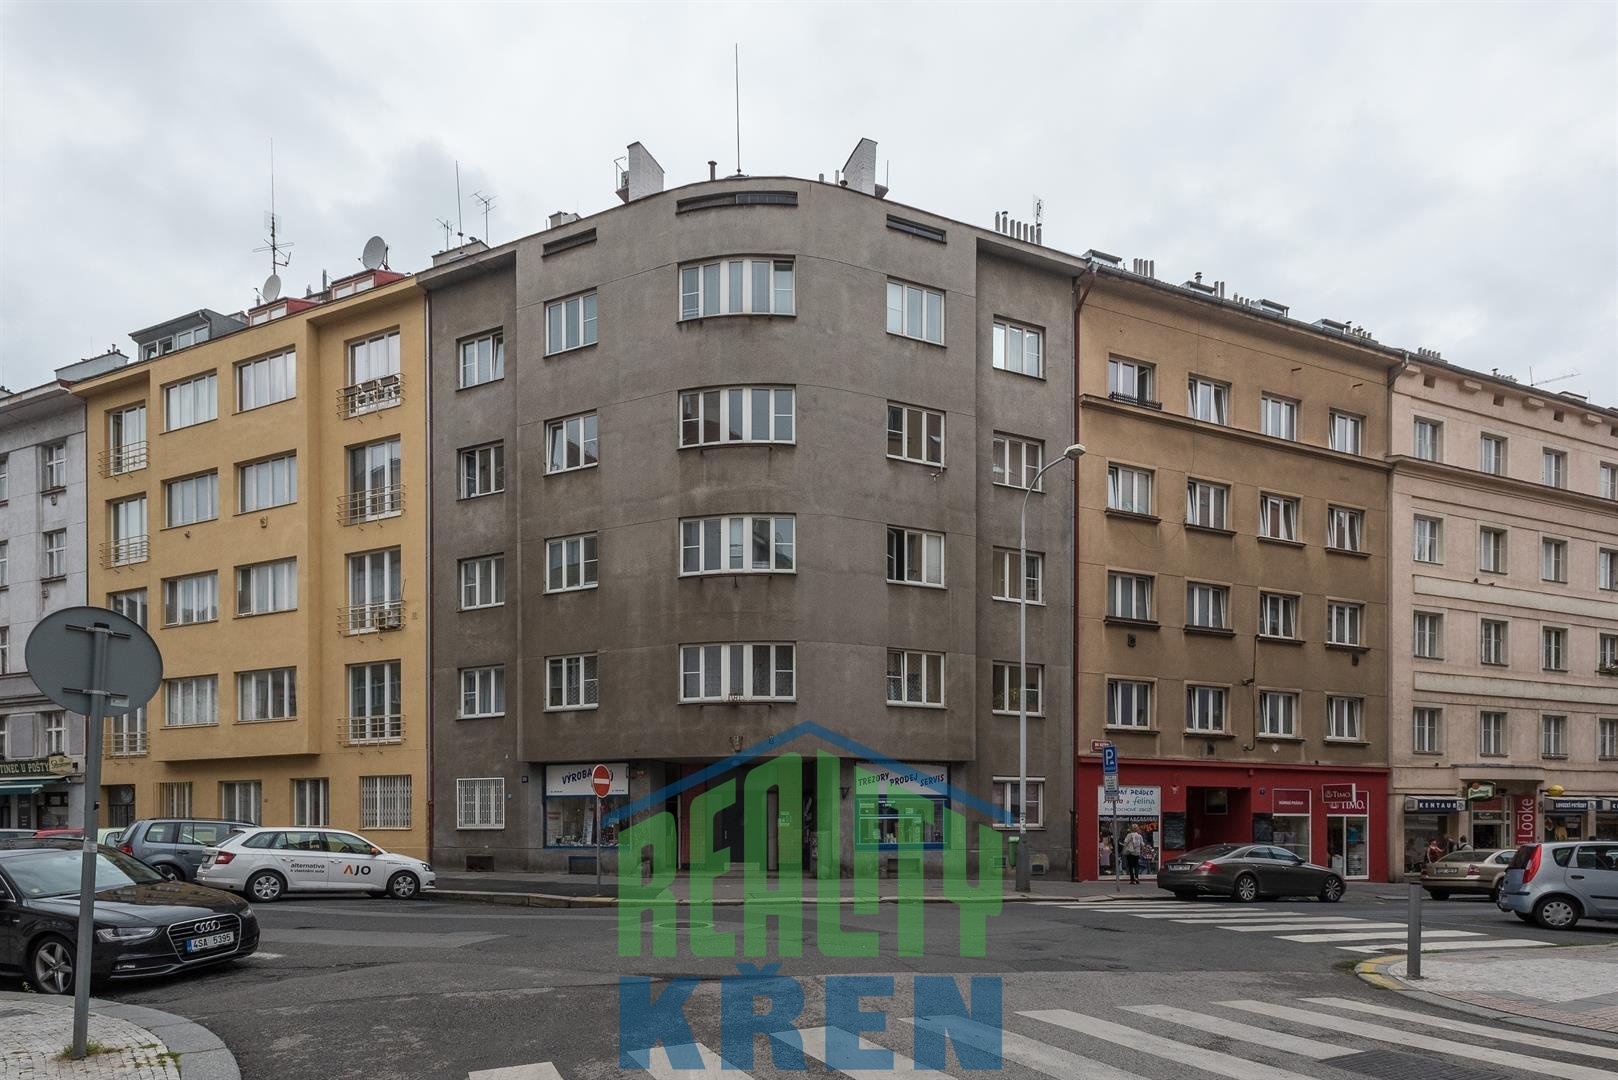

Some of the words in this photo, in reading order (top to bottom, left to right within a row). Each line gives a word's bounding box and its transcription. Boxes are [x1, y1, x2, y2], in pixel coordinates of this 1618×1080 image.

[1105, 749, 1114, 766] P
[858, 772, 890, 787] TREZORY
[890, 773, 919, 787] PRODEJ
[920, 774, 945, 787] SERVIS
[1133, 796, 1155, 806] felina
[1517, 798, 1534, 838] Looke
[343, 864, 371, 876] AJO
